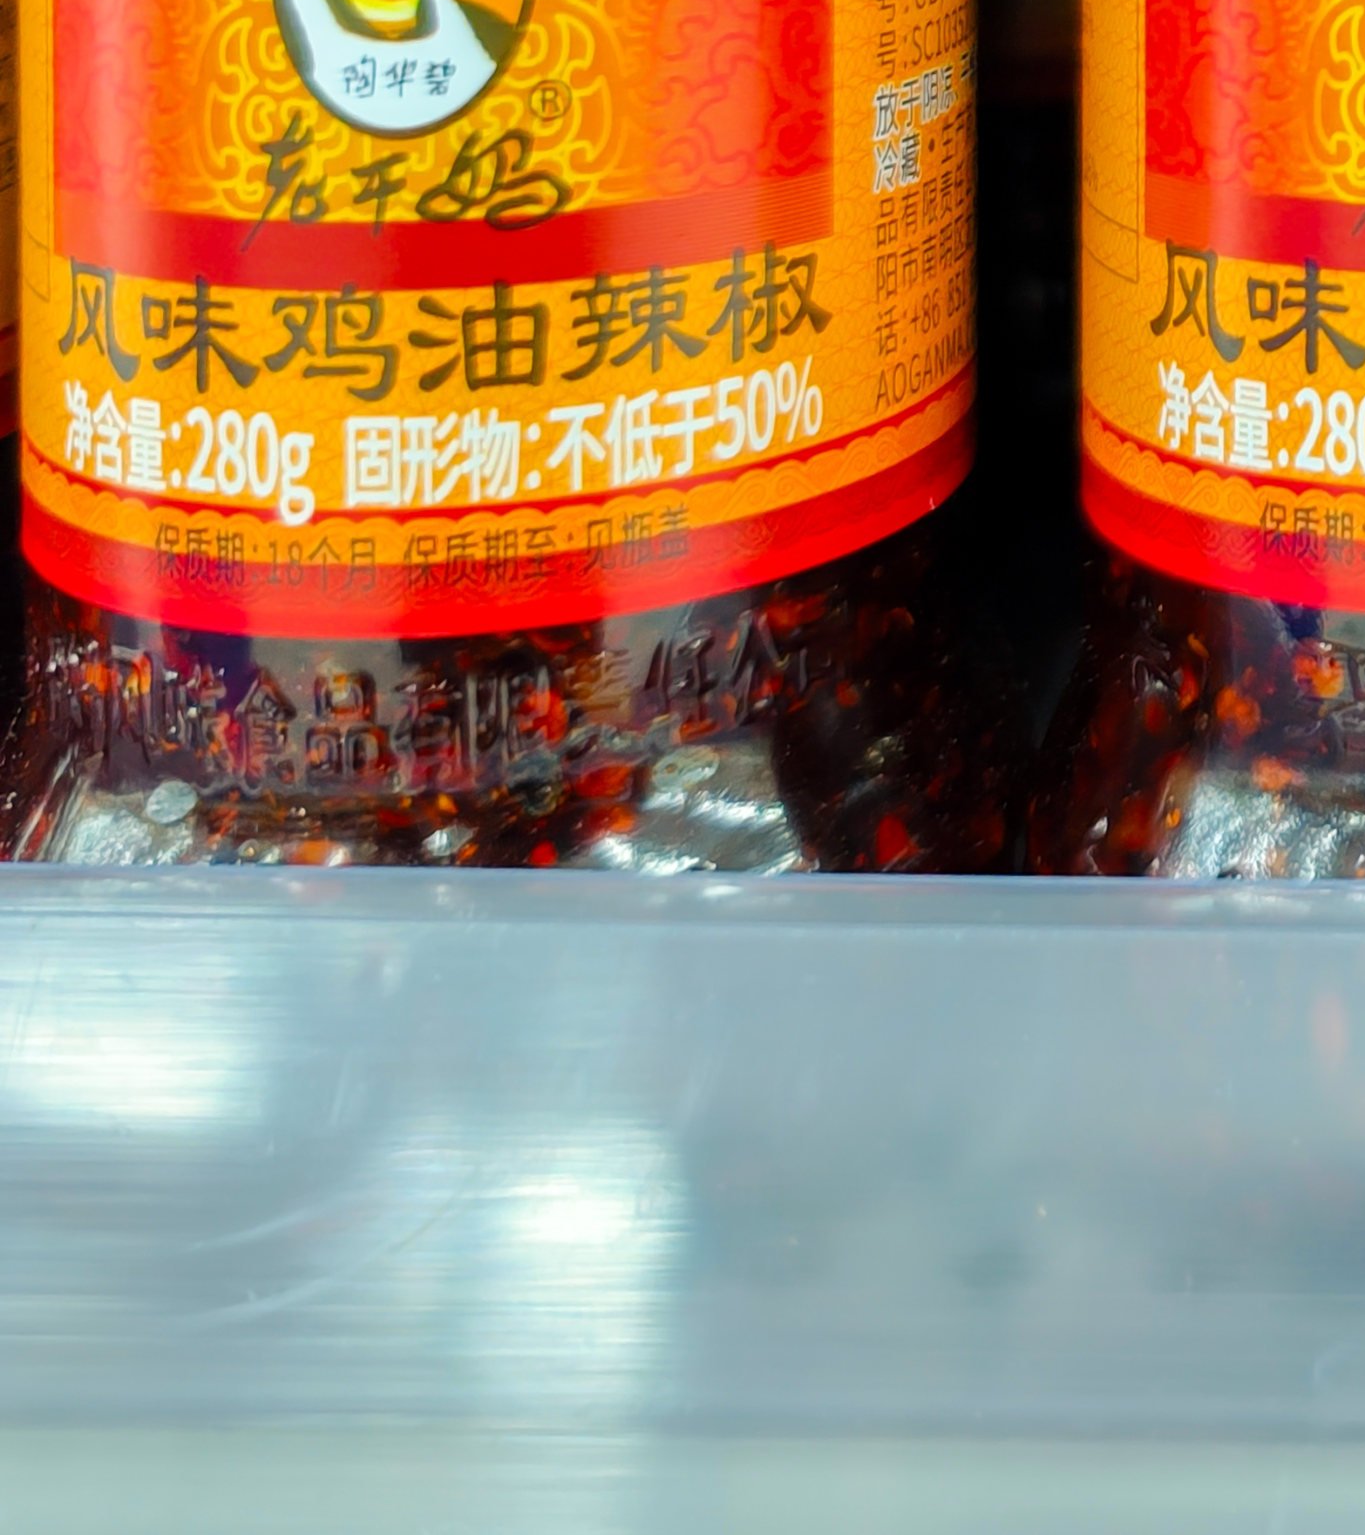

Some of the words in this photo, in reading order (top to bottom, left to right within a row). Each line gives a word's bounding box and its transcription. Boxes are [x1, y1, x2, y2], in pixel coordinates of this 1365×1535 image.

[58, 239, 835, 403] 风味鸡油辣椒
